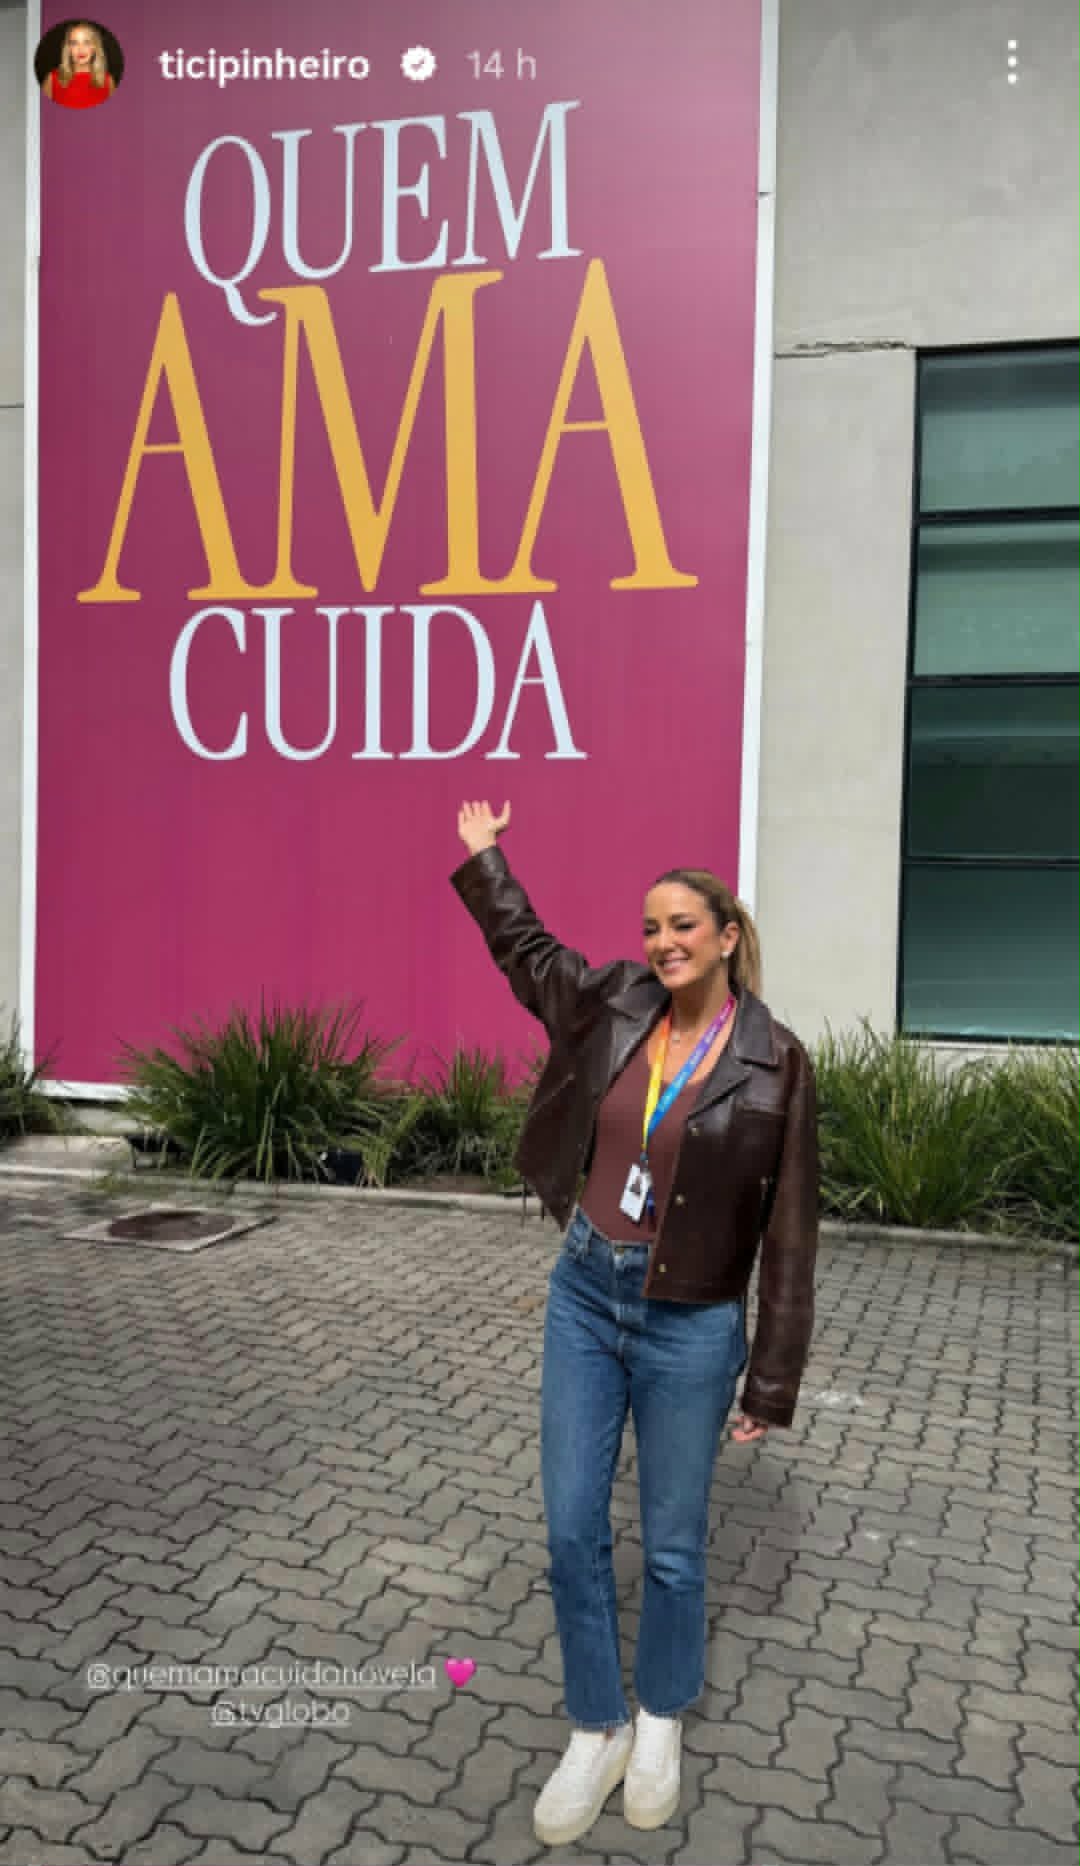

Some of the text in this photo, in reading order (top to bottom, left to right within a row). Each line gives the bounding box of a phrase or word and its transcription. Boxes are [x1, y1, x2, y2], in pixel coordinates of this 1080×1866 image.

[184, 100, 582, 326] QUEM
[77, 258, 698, 602] AMA
[169, 600, 587, 760] CUIDA
